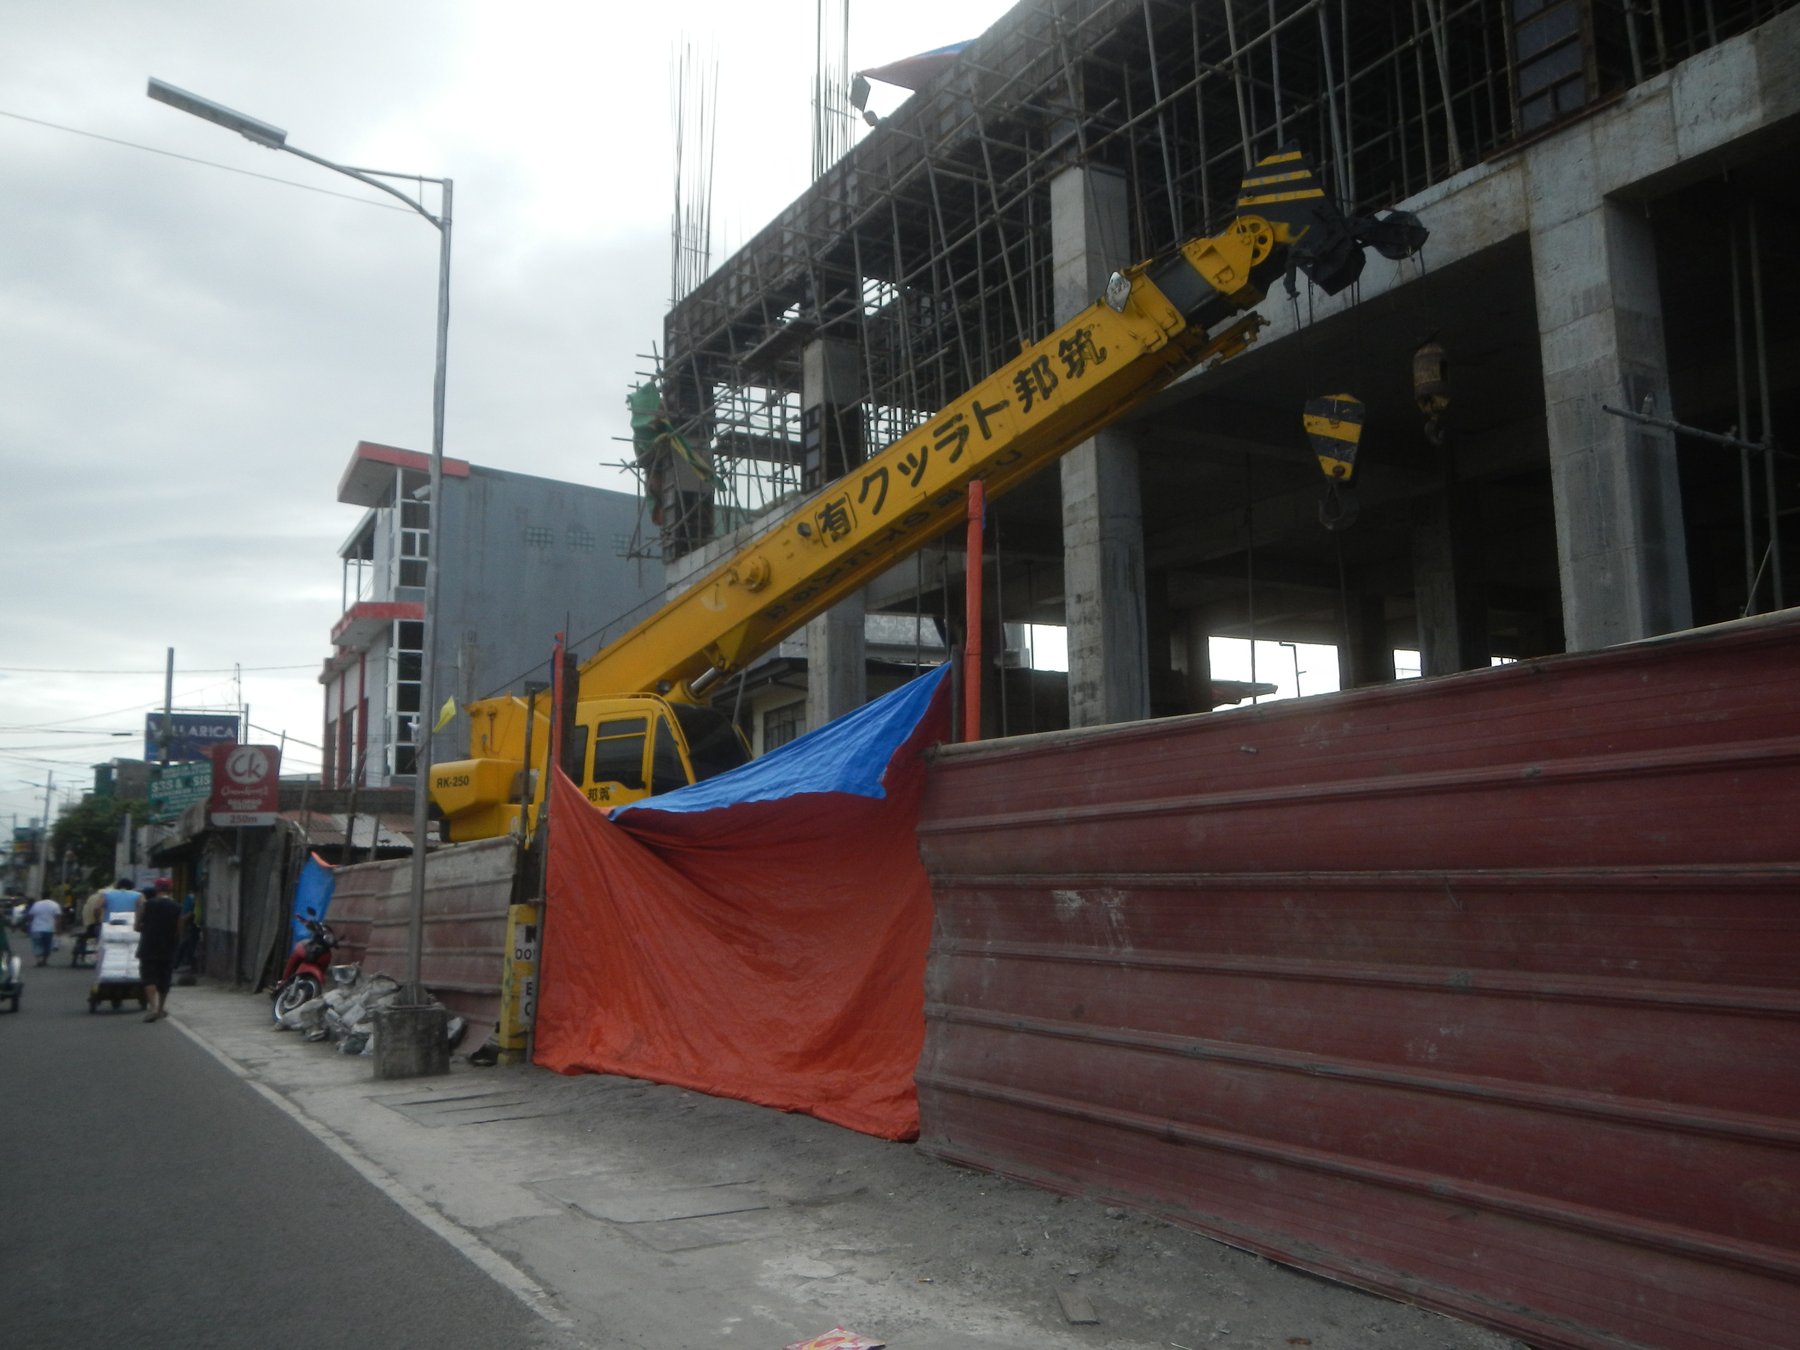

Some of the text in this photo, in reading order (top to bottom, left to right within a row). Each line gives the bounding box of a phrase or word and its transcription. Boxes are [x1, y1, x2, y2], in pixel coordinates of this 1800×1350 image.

[149, 721, 234, 740] VLLARICA
[231, 752, 262, 778] Ck
[436, 776, 469, 788] RK-250
